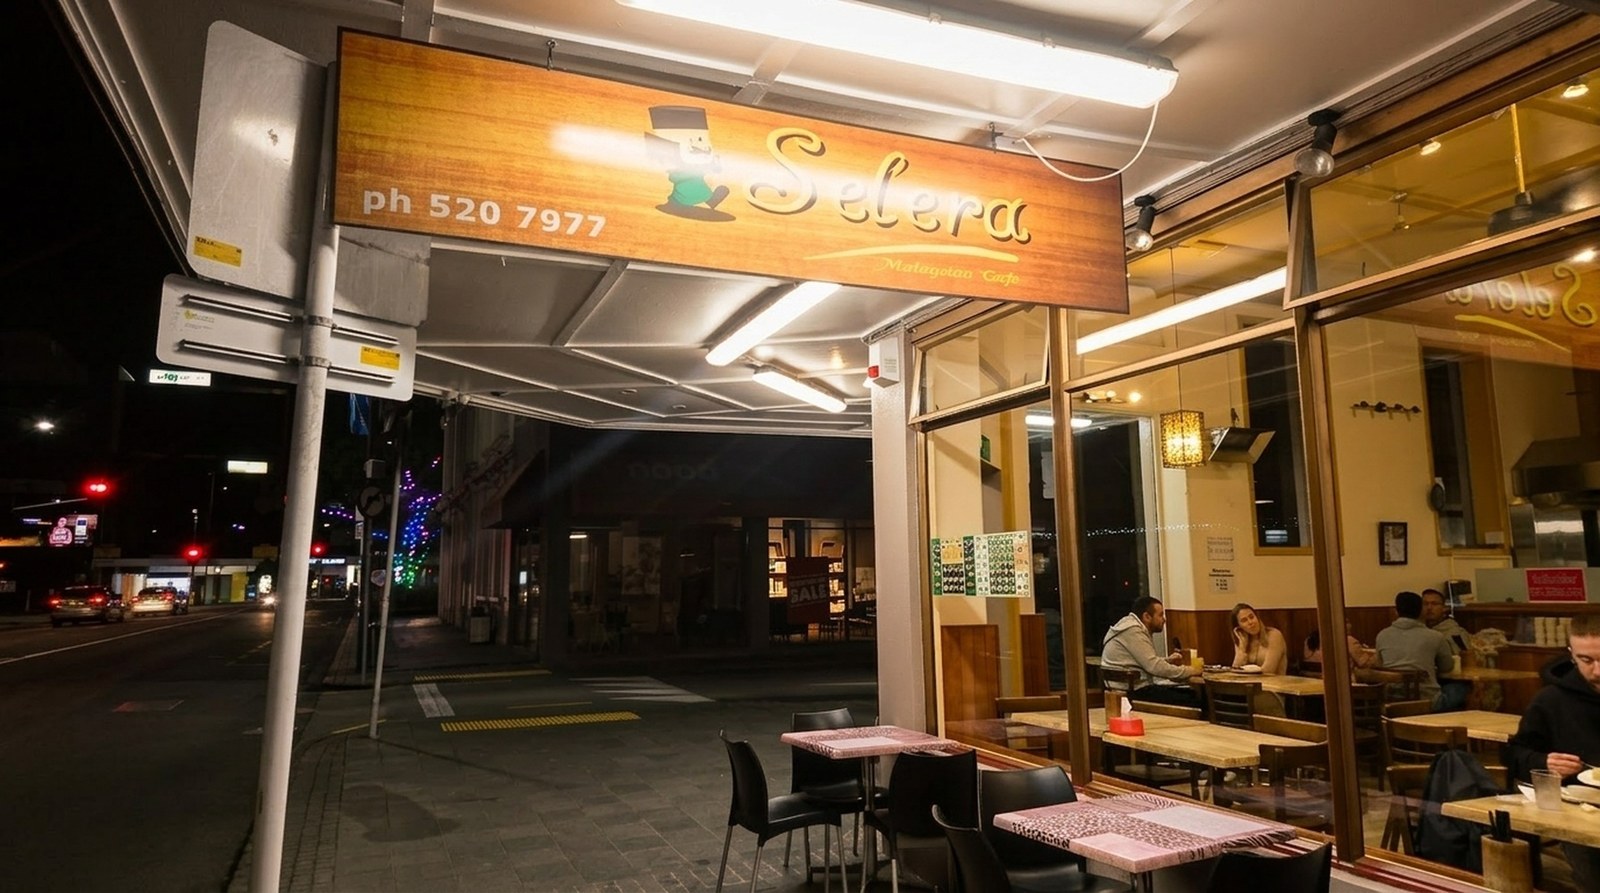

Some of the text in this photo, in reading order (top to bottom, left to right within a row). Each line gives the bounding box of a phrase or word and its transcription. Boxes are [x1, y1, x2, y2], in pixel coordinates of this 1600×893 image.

[743, 127, 1031, 244] Selera
[363, 188, 606, 238] ph 520 7977
[791, 584, 827, 604] SALE
